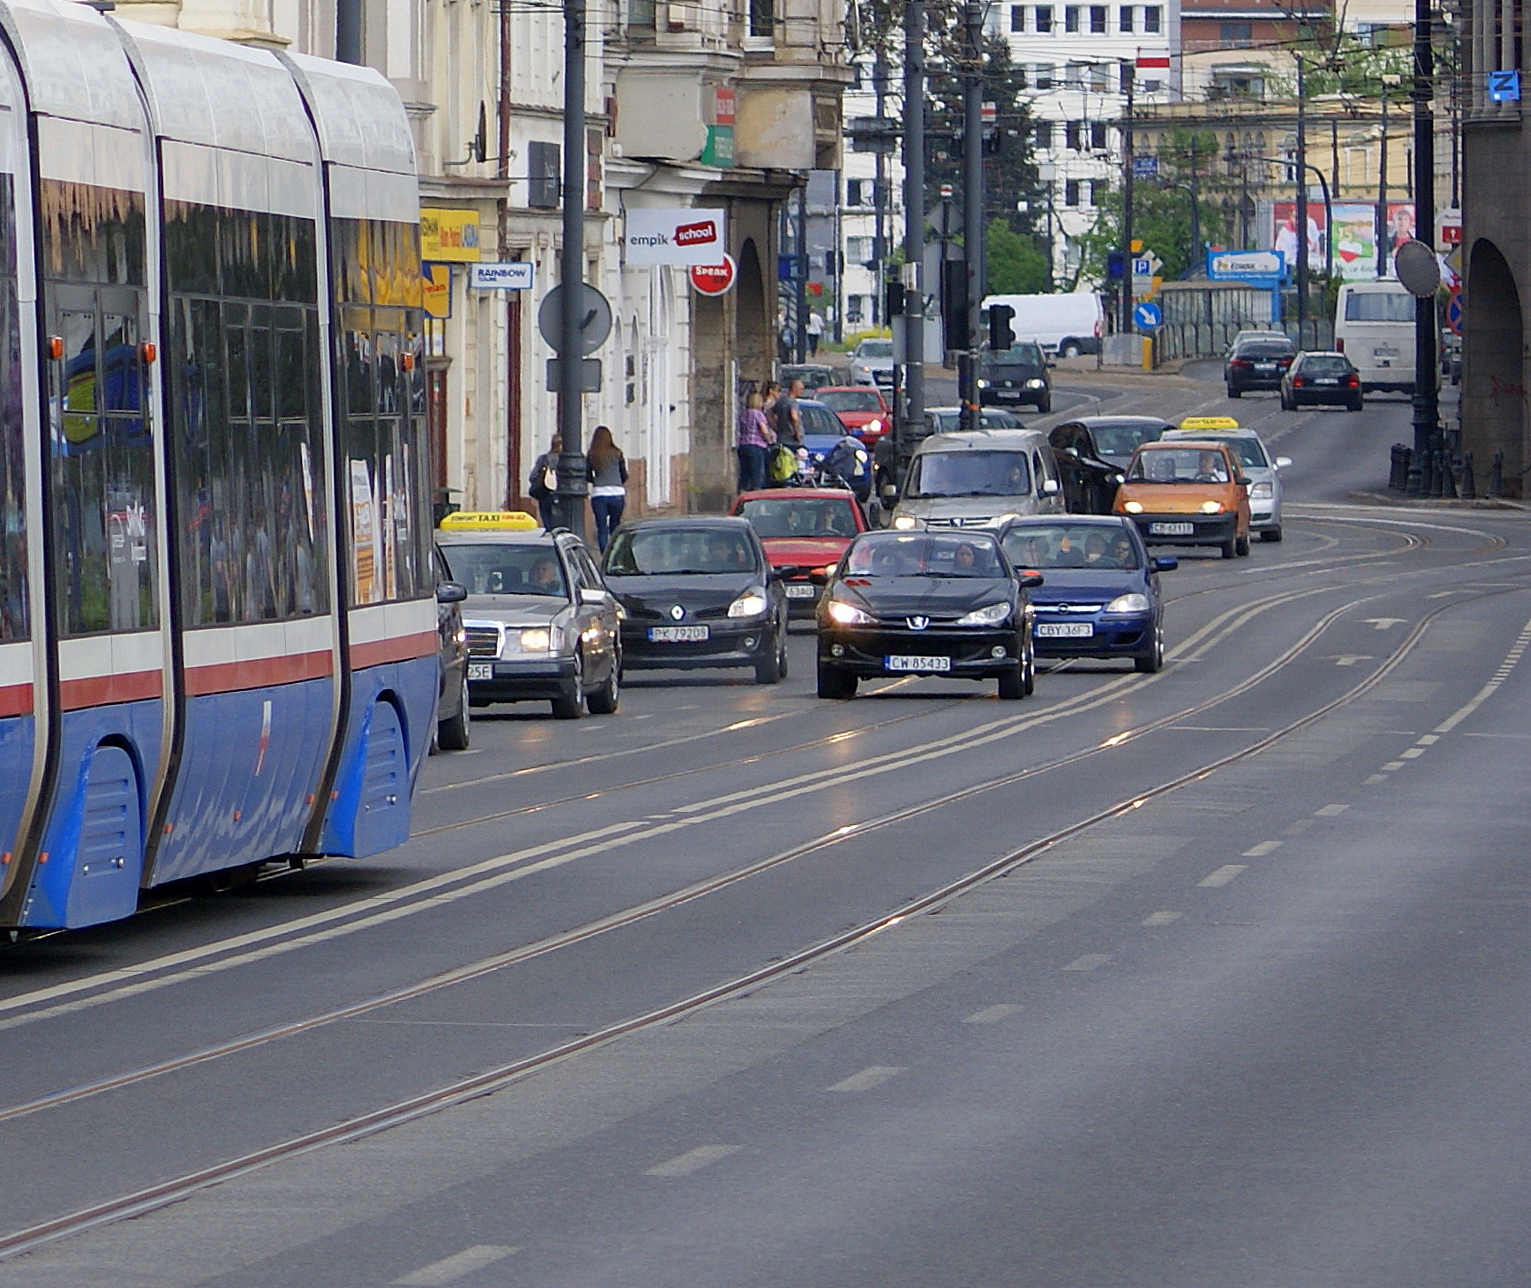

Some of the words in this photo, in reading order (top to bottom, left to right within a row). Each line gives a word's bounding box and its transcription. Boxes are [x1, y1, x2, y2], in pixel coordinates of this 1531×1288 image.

[630, 233, 669, 247] empik
[678, 225, 713, 241] school
[478, 269, 526, 278] RAINBOW
[892, 658, 909, 668] CW
[913, 658, 949, 669] 85433
